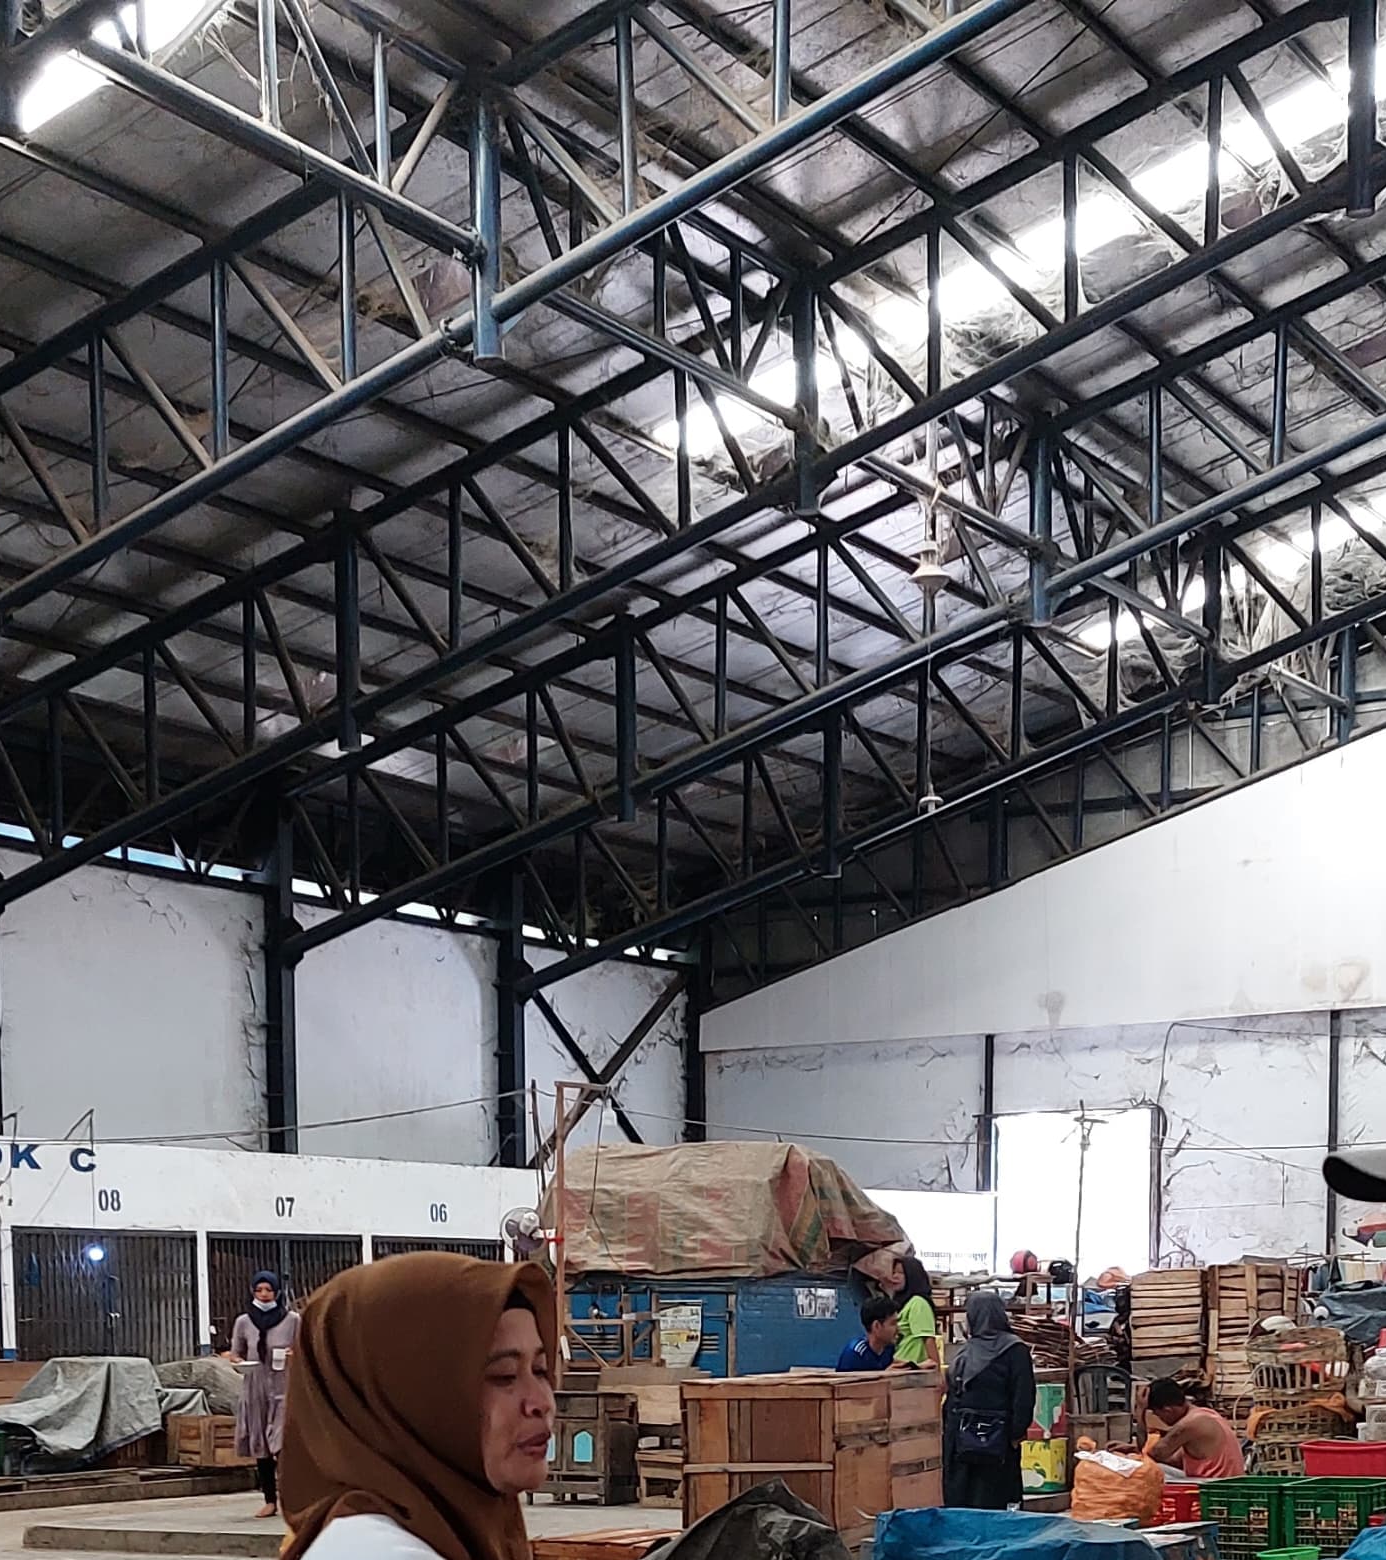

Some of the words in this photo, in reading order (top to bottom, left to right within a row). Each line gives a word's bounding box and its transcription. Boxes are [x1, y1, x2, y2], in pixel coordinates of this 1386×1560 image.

[70, 1148, 96, 1172] C
[98, 1189, 121, 1212] 08
[275, 1196, 295, 1217] 07
[430, 1203, 448, 1223] 06
